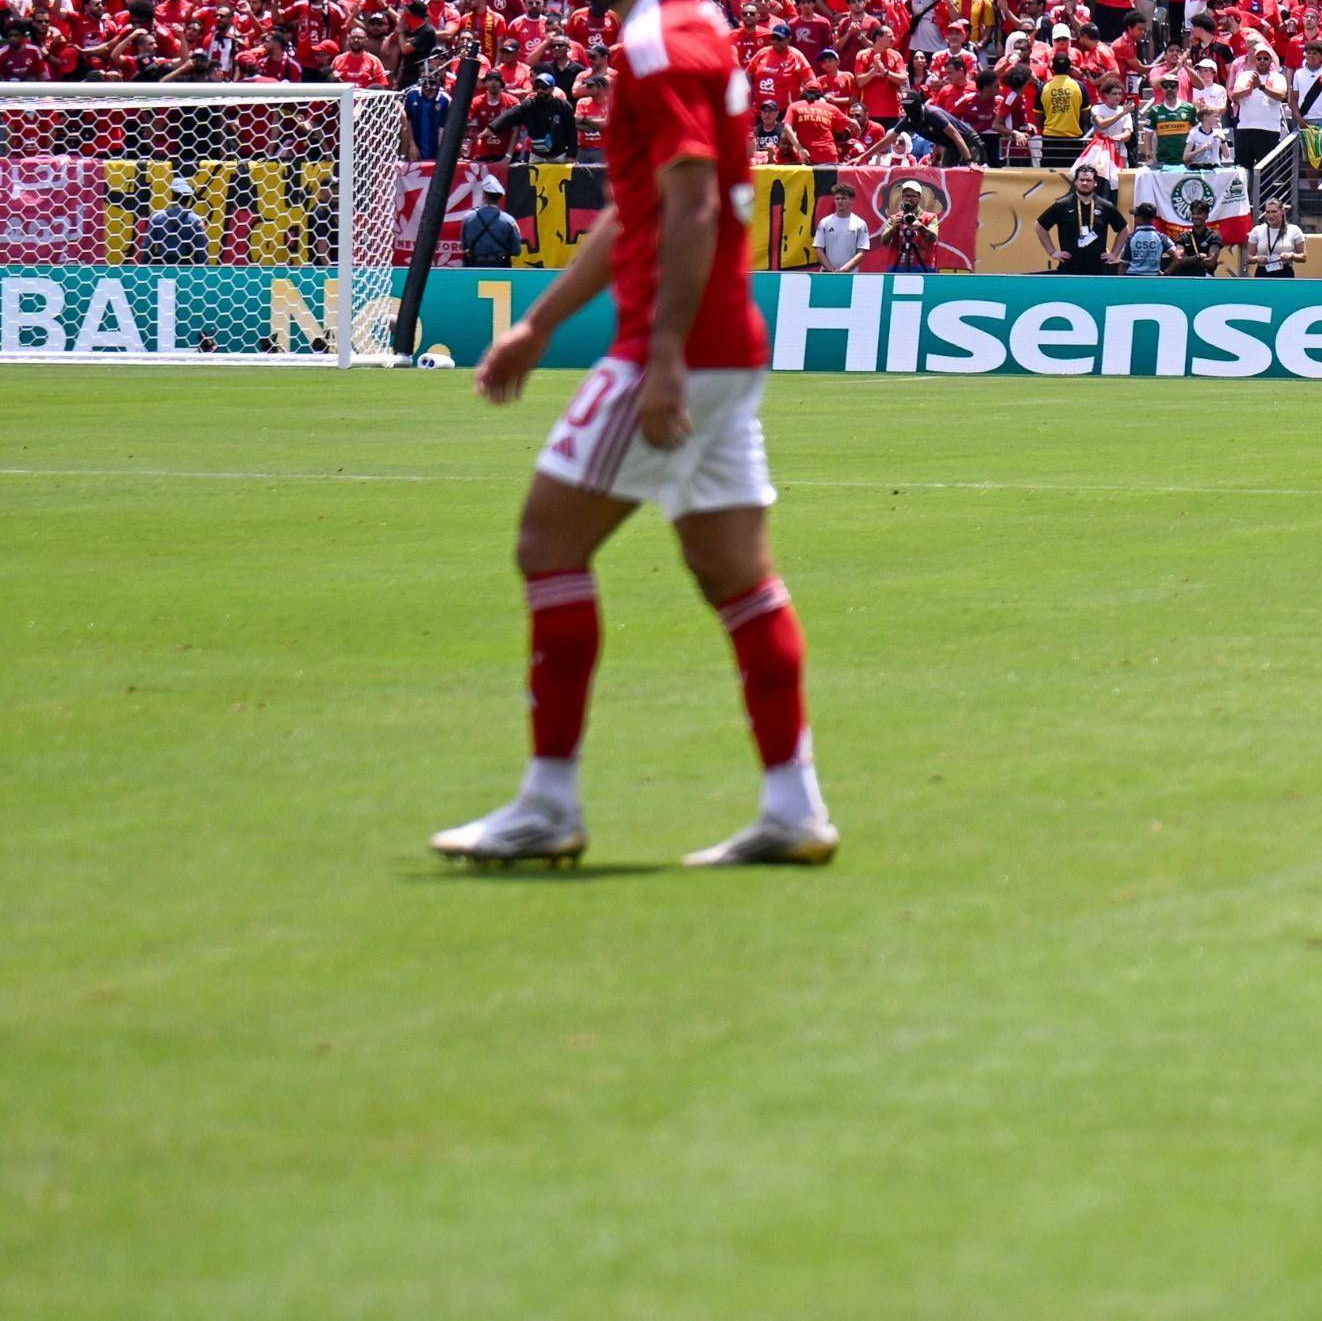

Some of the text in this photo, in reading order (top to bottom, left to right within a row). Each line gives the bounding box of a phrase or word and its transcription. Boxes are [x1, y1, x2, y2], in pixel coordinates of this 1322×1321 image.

[1051, 88, 1070, 96] CSC
[1052, 97, 1070, 105] EVENT
[1135, 240, 1157, 249] CSC
